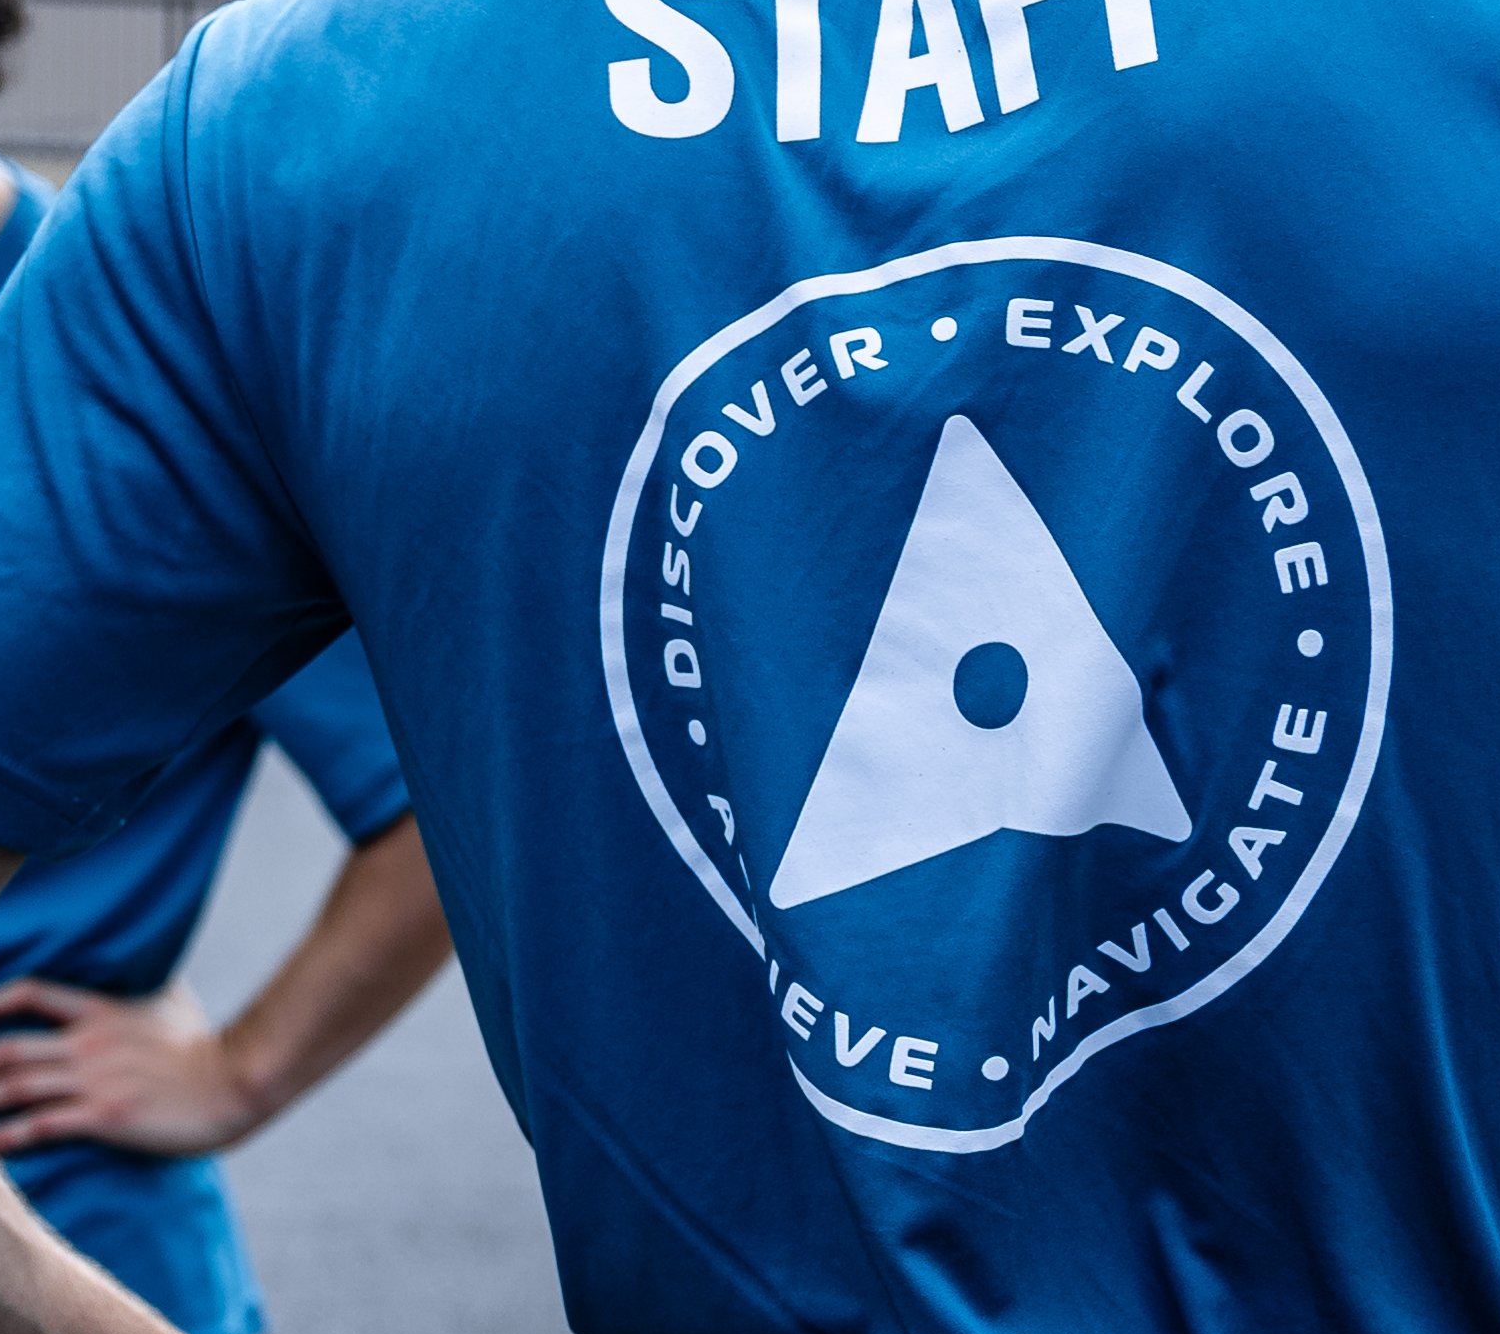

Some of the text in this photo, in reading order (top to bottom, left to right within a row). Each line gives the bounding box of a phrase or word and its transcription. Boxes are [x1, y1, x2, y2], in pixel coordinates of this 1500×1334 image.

[661, 298, 1328, 1090] DISCOVER EXPLORE NAVIGATE AIEVE
